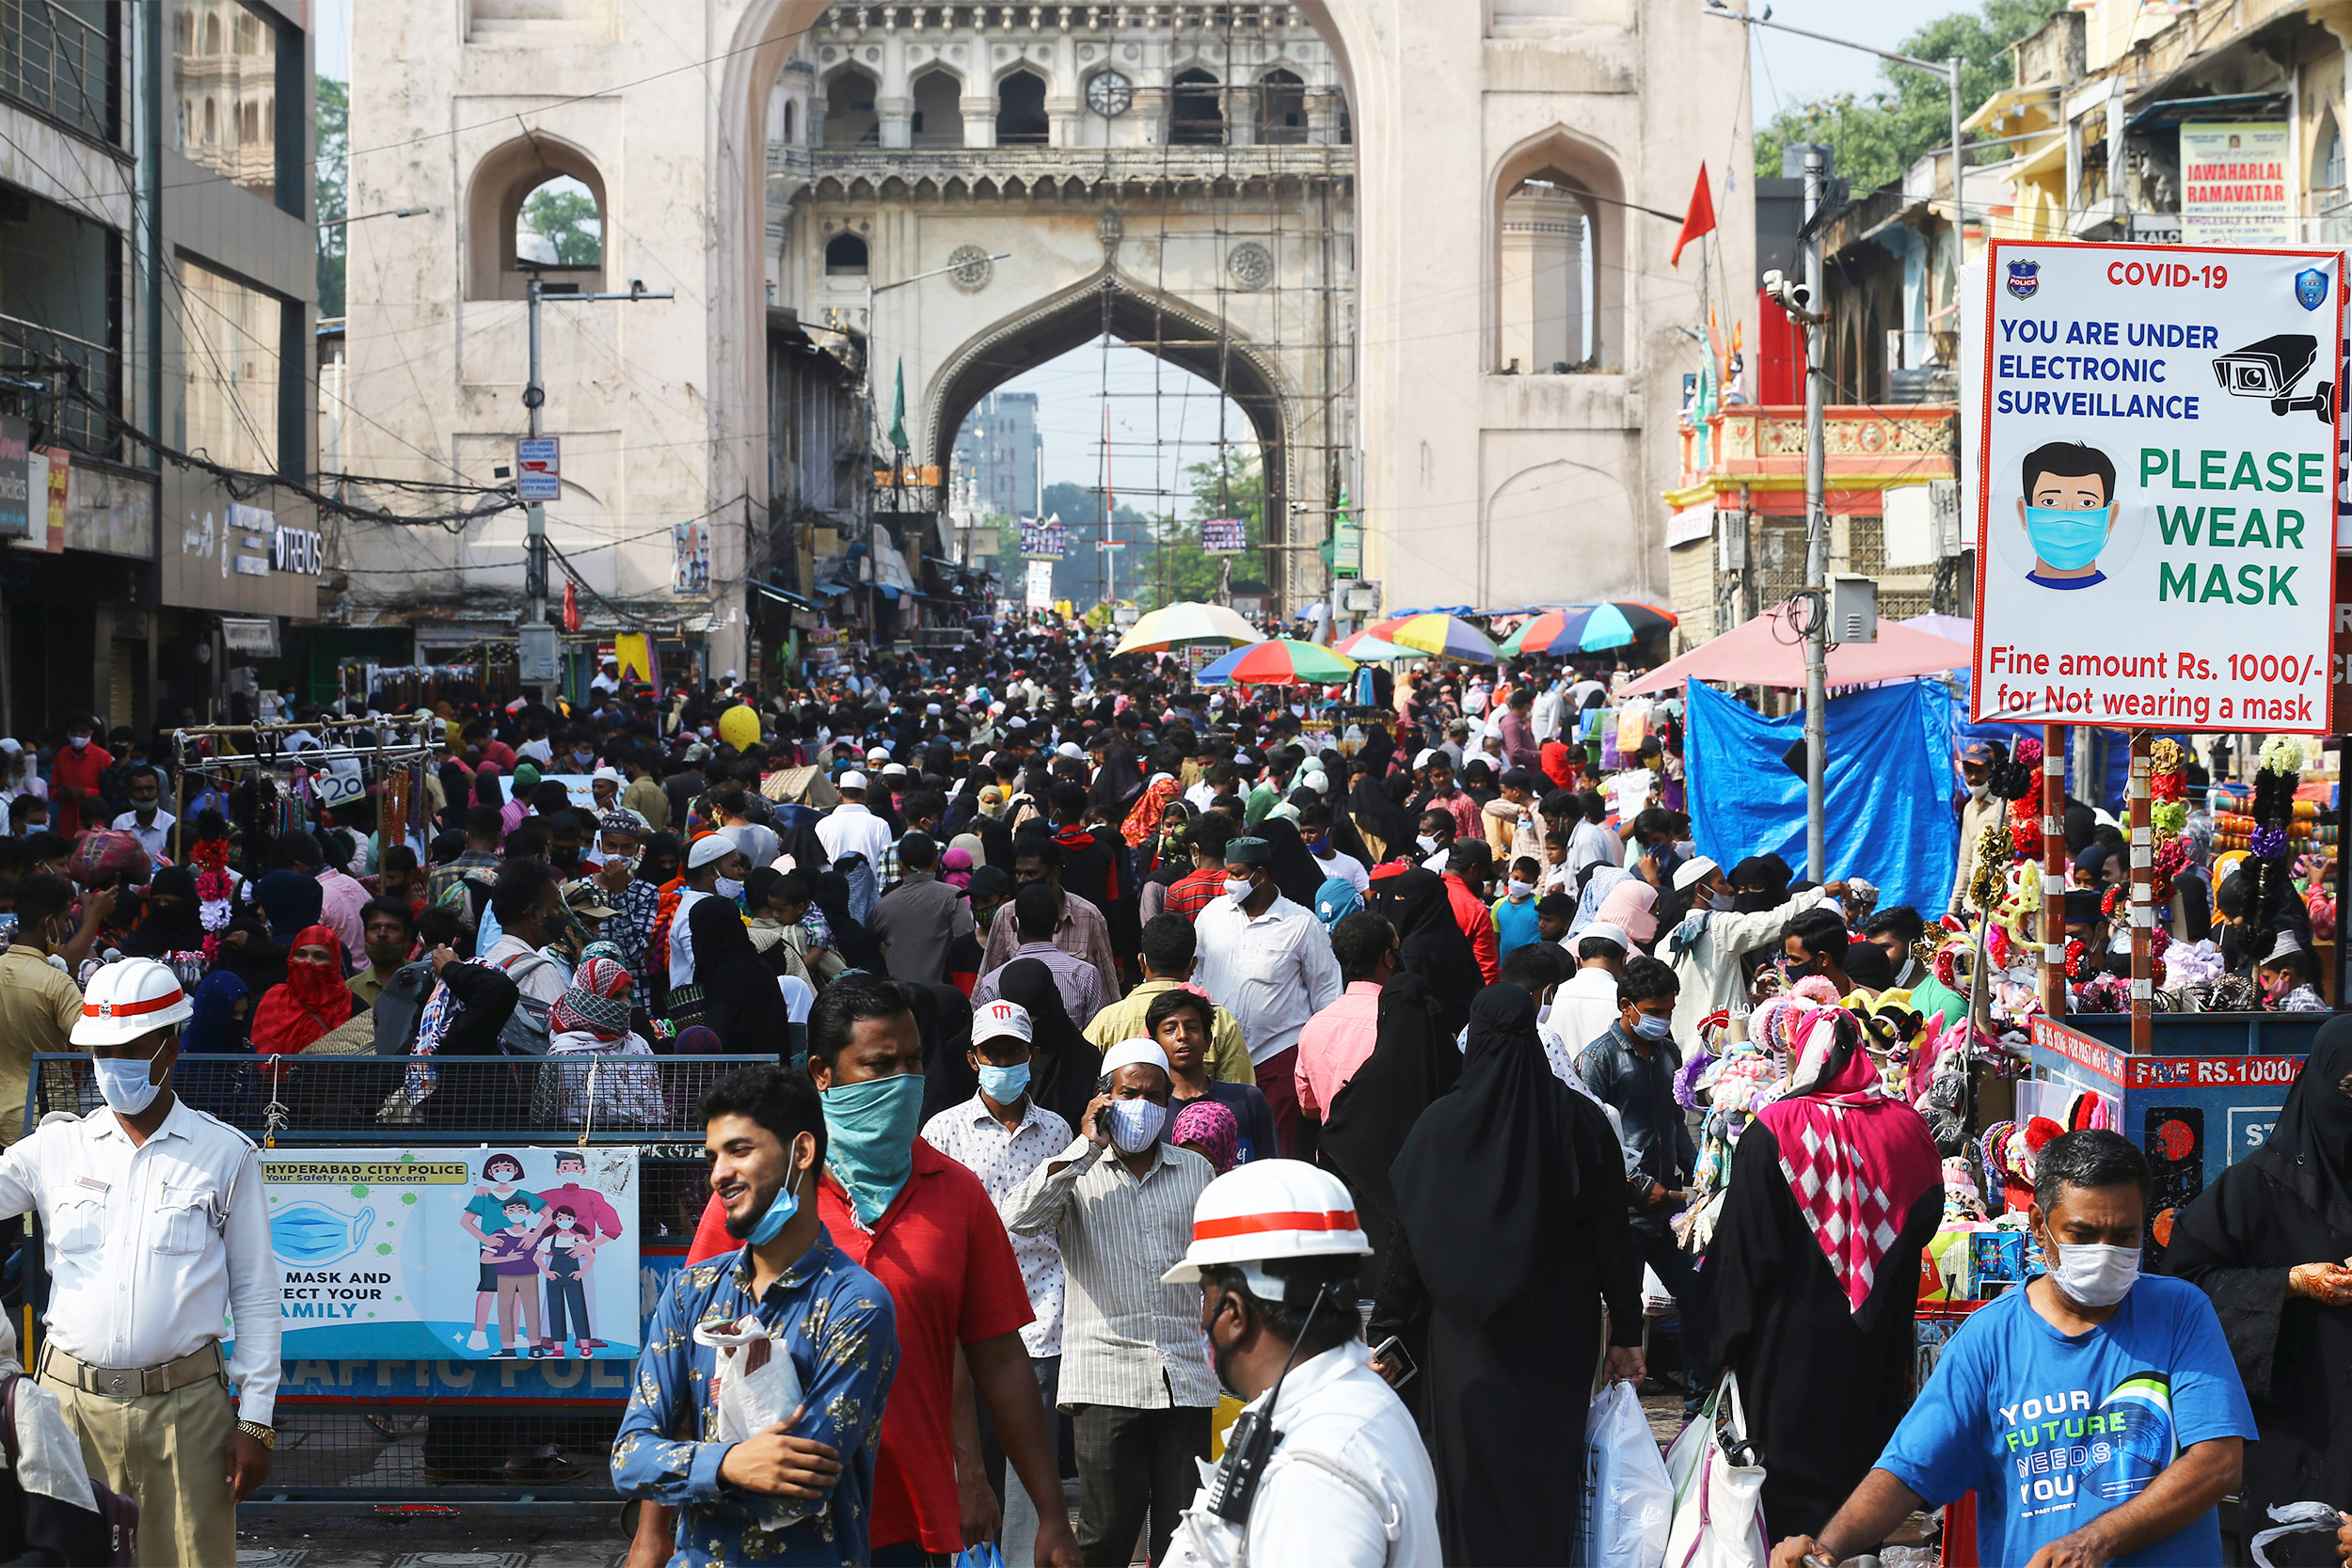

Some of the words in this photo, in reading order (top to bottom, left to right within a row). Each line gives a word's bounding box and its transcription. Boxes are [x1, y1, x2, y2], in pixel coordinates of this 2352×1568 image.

[2188, 163, 2282, 182] JAWAHARLAL
[2188, 185, 2284, 203] RAMAVATAR
[2187, 216, 2242, 225] WHOLESALE
[2108, 262, 2227, 289] COVID-19
[2001, 320, 2057, 343] YOU
[2066, 322, 2119, 345] ARE
[2128, 324, 2217, 349] UNDER
[2000, 356, 2166, 382] ELECTRONIC
[1998, 390, 2199, 419] SURVEILLANCE
[2141, 449, 2324, 492] PLEASE
[2157, 506, 2304, 548] WEAR
[2160, 562, 2297, 605] MASK
[1991, 645, 2049, 674] Fine
[2059, 653, 2167, 678] amount
[2179, 653, 2217, 679] Rs.
[2229, 655, 2322, 685] 1000/-
[1998, 684, 2036, 711] for
[2046, 686, 2092, 713] Not
[2102, 689, 2209, 724] wearing
[2220, 698, 2233, 718] a
[2244, 694, 2312, 721] mask
[324, 778, 362, 800] 20
[2068, 1037, 2078, 1059] FOR
[266, 1165, 361, 1174] HYDERABAD
[368, 1165, 402, 1174] CITY
[408, 1165, 464, 1174] POLICE
[286, 1273, 342, 1284] MASK
[349, 1273, 391, 1284] AND
[327, 1289, 382, 1300] YOUR
[1999, 1390, 2091, 1427] YOUR
[2006, 1412, 2127, 1452] FUTURE
[2017, 1442, 2111, 1479] NEEDS
[2021, 1475, 2075, 1505] YOU
[2035, 1507, 2051, 1515] PAST
